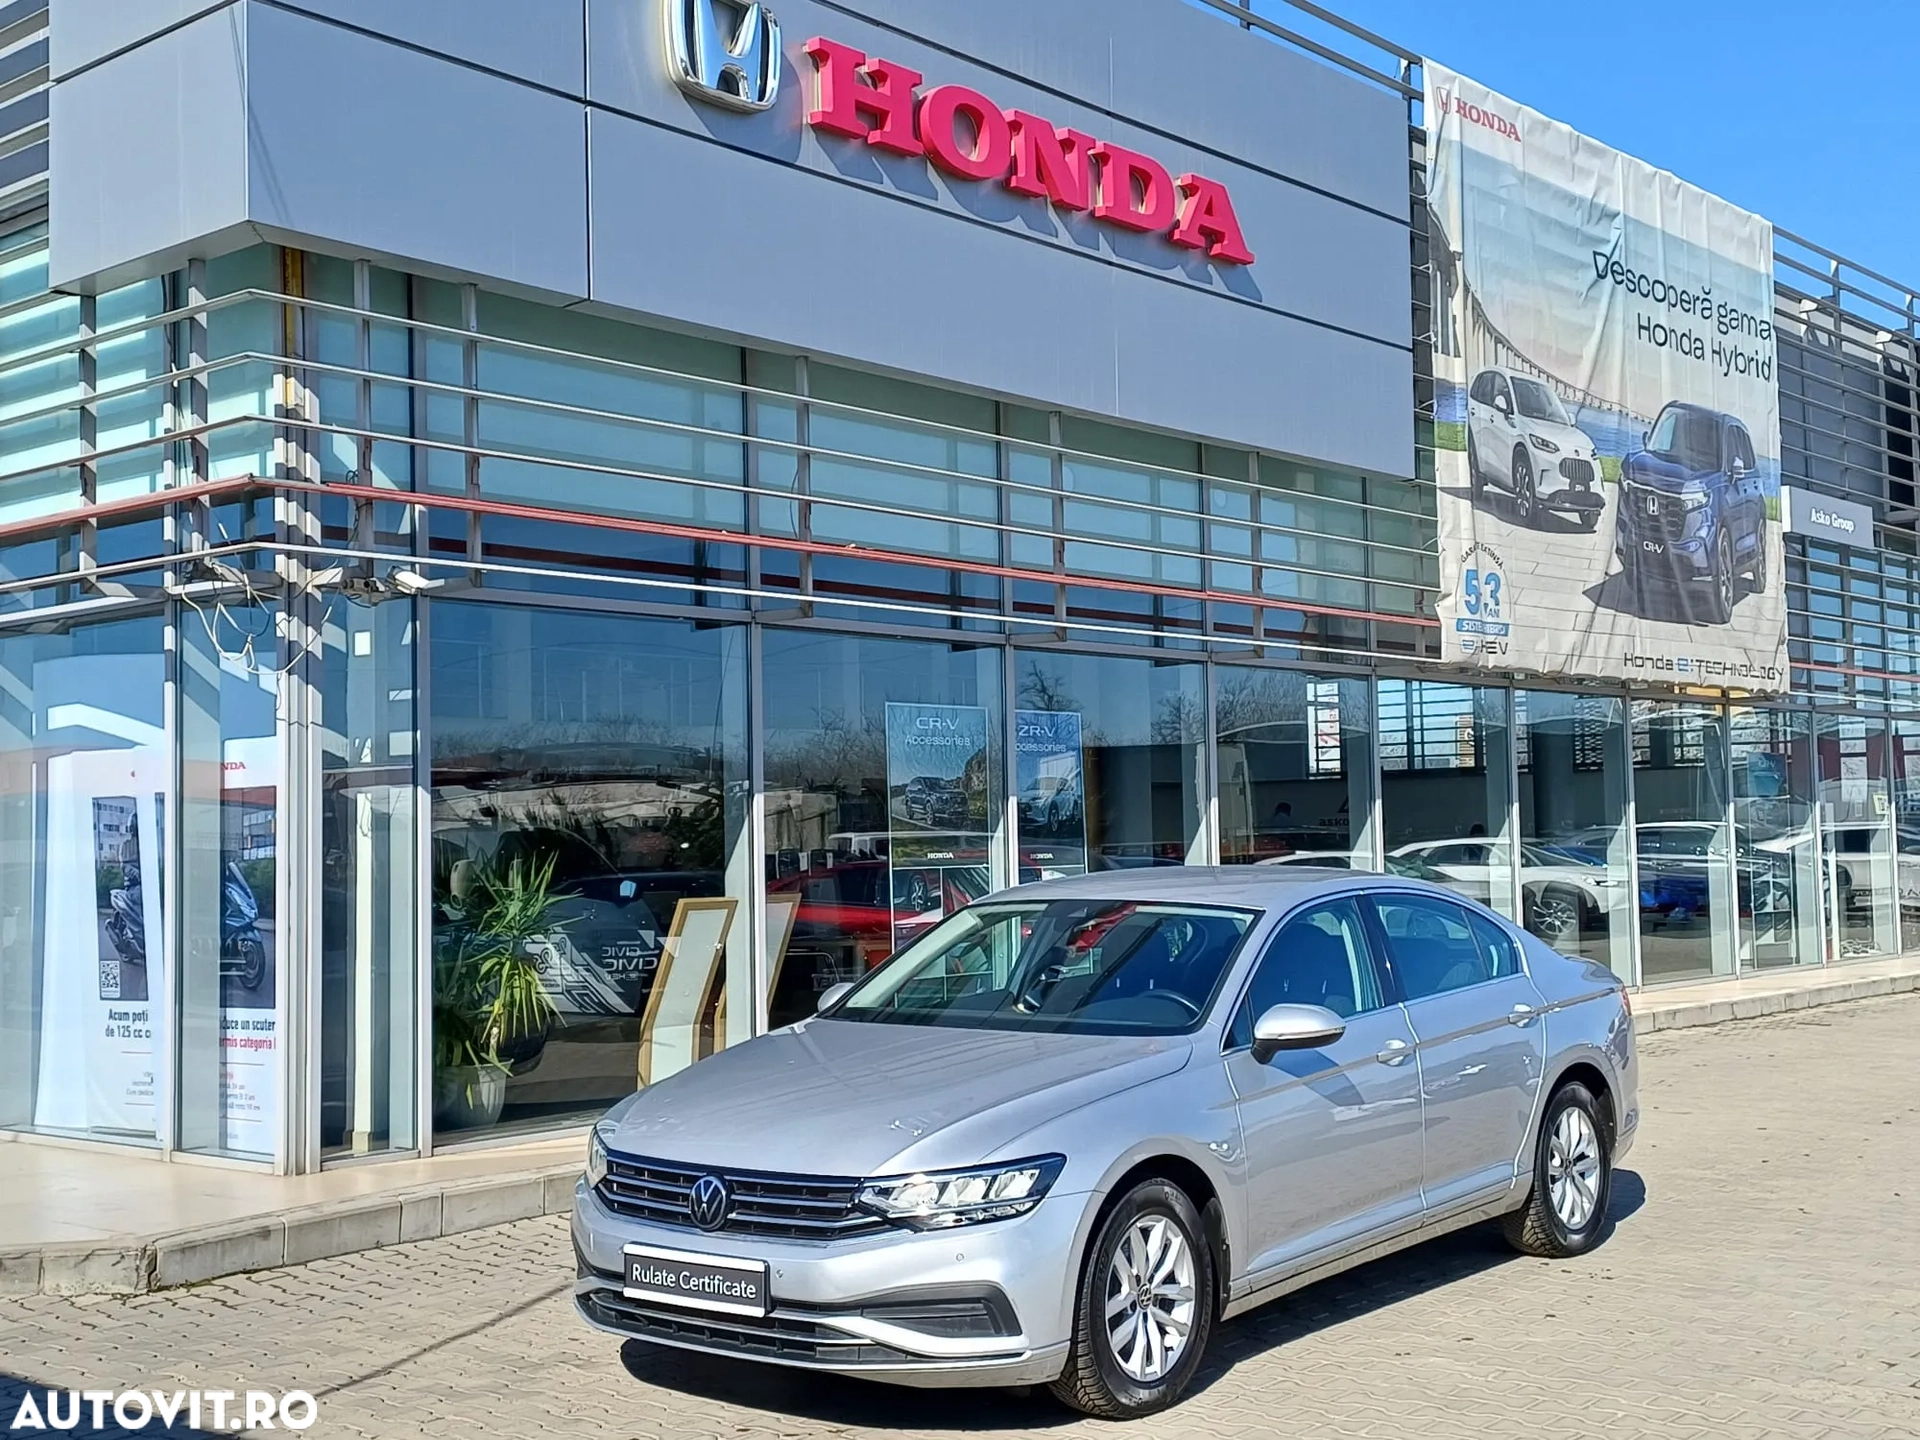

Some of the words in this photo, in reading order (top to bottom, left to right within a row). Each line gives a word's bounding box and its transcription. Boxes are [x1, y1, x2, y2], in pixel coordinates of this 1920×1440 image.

[1454, 96, 1522, 142] HONDA
[802, 36, 1255, 266] HONDA
[1592, 250, 1713, 320] Descoperă
[1717, 301, 1773, 341] gama
[1637, 312, 1705, 361] Honda
[1711, 337, 1773, 383] Hybrid
[1811, 507, 1831, 526] Asko
[1831, 512, 1855, 534] Group
[1624, 652, 1674, 670] Honda
[916, 716, 960, 730] CR-V
[1018, 725, 1056, 737] ZR-V
[904, 734, 971, 746] Accessories
[1014, 741, 1067, 752] ccessories
[220, 761, 246, 770] NDA
[927, 852, 954, 860] HONDA
[1029, 852, 1053, 860] HONDA
[108, 1008, 130, 1021] Acum
[105, 1024, 115, 1037] de
[117, 1024, 131, 1038] 125
[133, 1028, 143, 1038] cc
[240, 1019, 250, 1030] un
[252, 1017, 276, 1031] scuter
[239, 1035, 272, 1051] categoria
[632, 1263, 676, 1287] Rulate
[679, 1271, 757, 1299] Certificate
